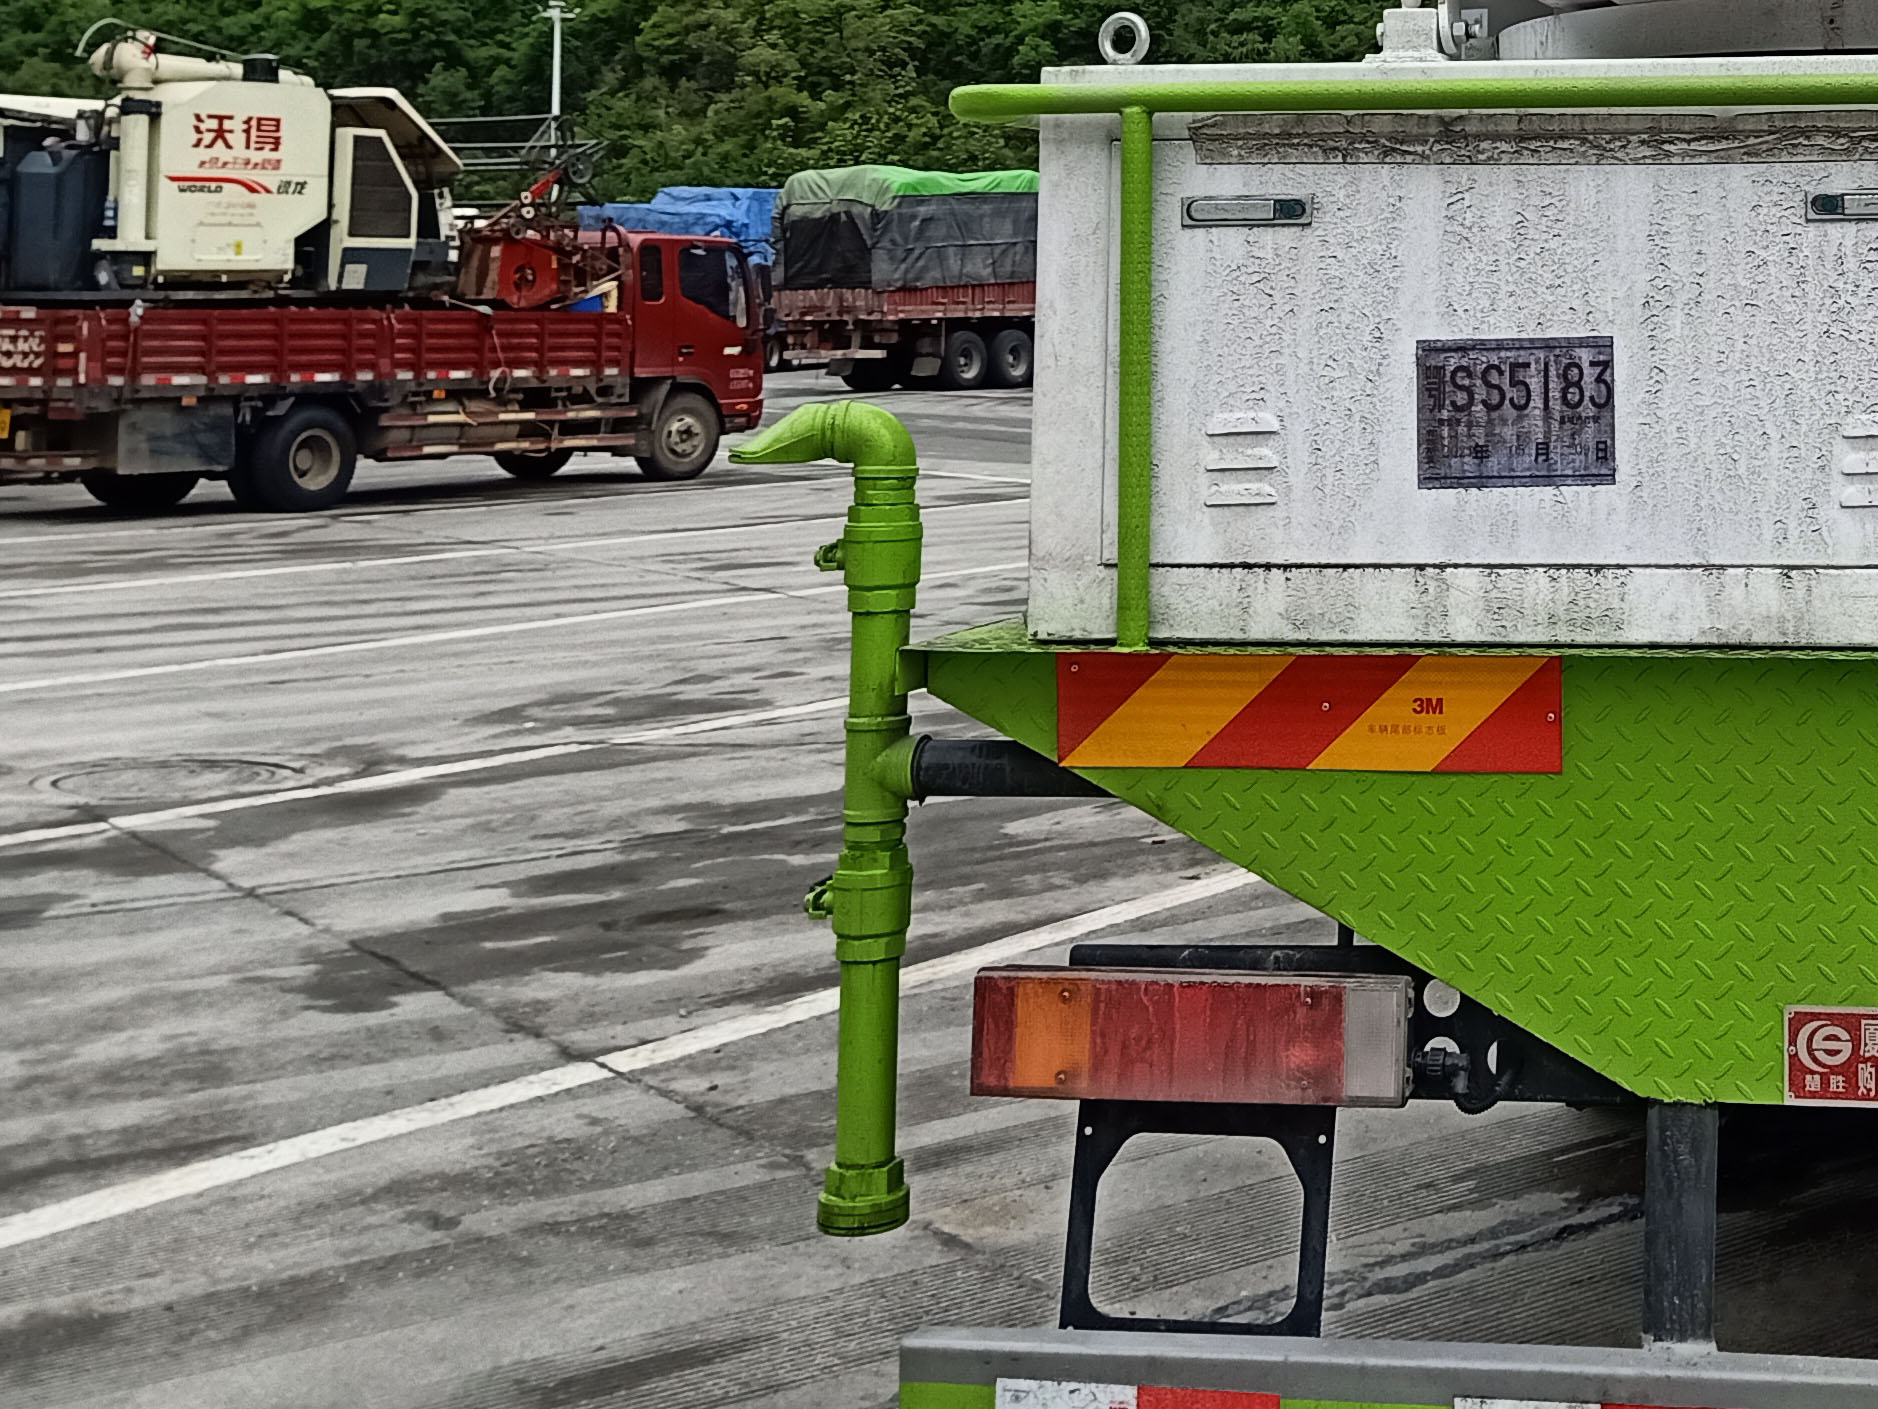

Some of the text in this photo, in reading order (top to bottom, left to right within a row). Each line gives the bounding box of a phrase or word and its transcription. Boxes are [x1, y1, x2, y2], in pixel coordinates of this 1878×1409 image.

[191, 112, 282, 152] 沃得
[1412, 697, 1444, 714] 3M
[1805, 1074, 1847, 1092] 楚胜
